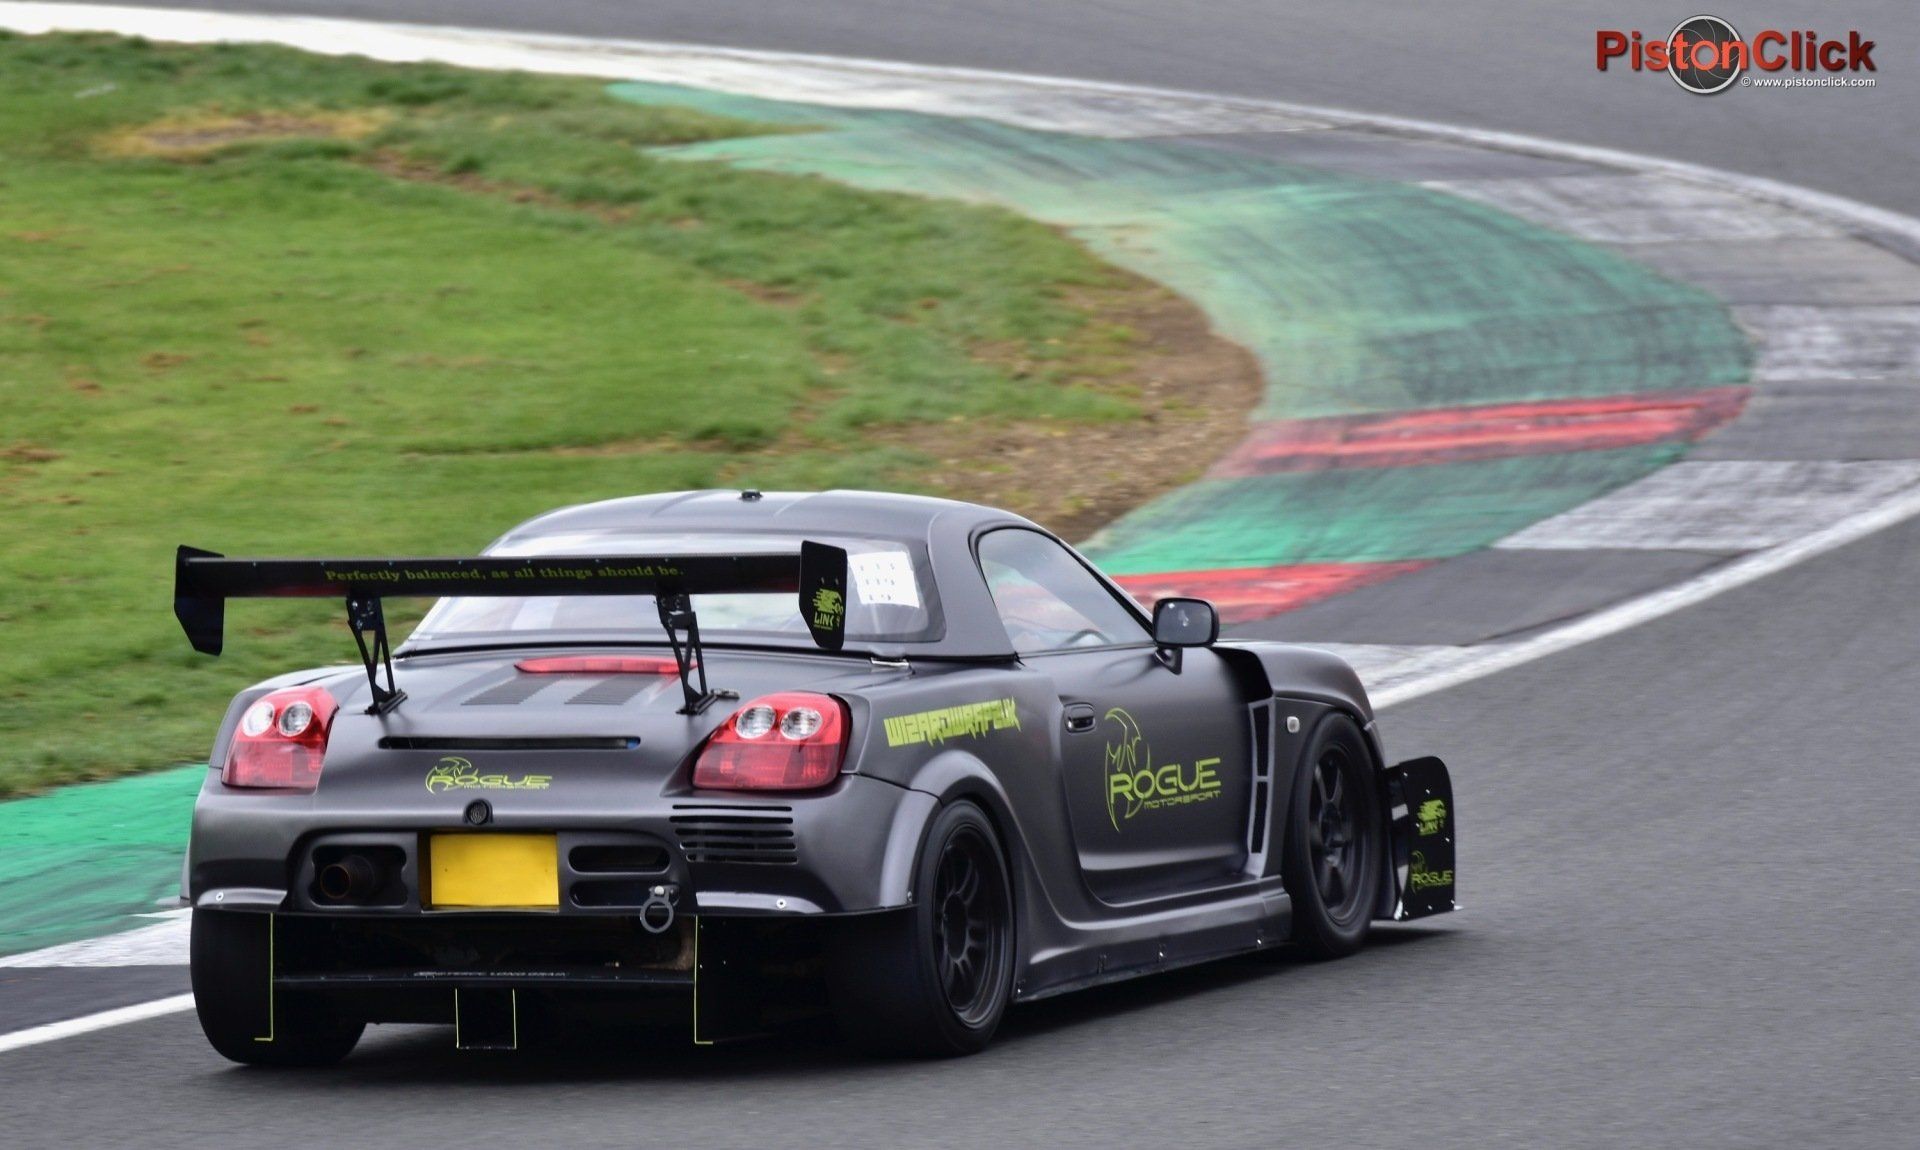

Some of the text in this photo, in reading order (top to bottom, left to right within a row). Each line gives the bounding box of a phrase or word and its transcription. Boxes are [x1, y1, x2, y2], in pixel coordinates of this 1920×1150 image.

[325, 565, 684, 582] Perfectly balanced, as all things should be.
[430, 775, 552, 786] ROGUE
[1110, 757, 1221, 804] ROGUE
[1143, 790, 1220, 809] MOTORSPORT
